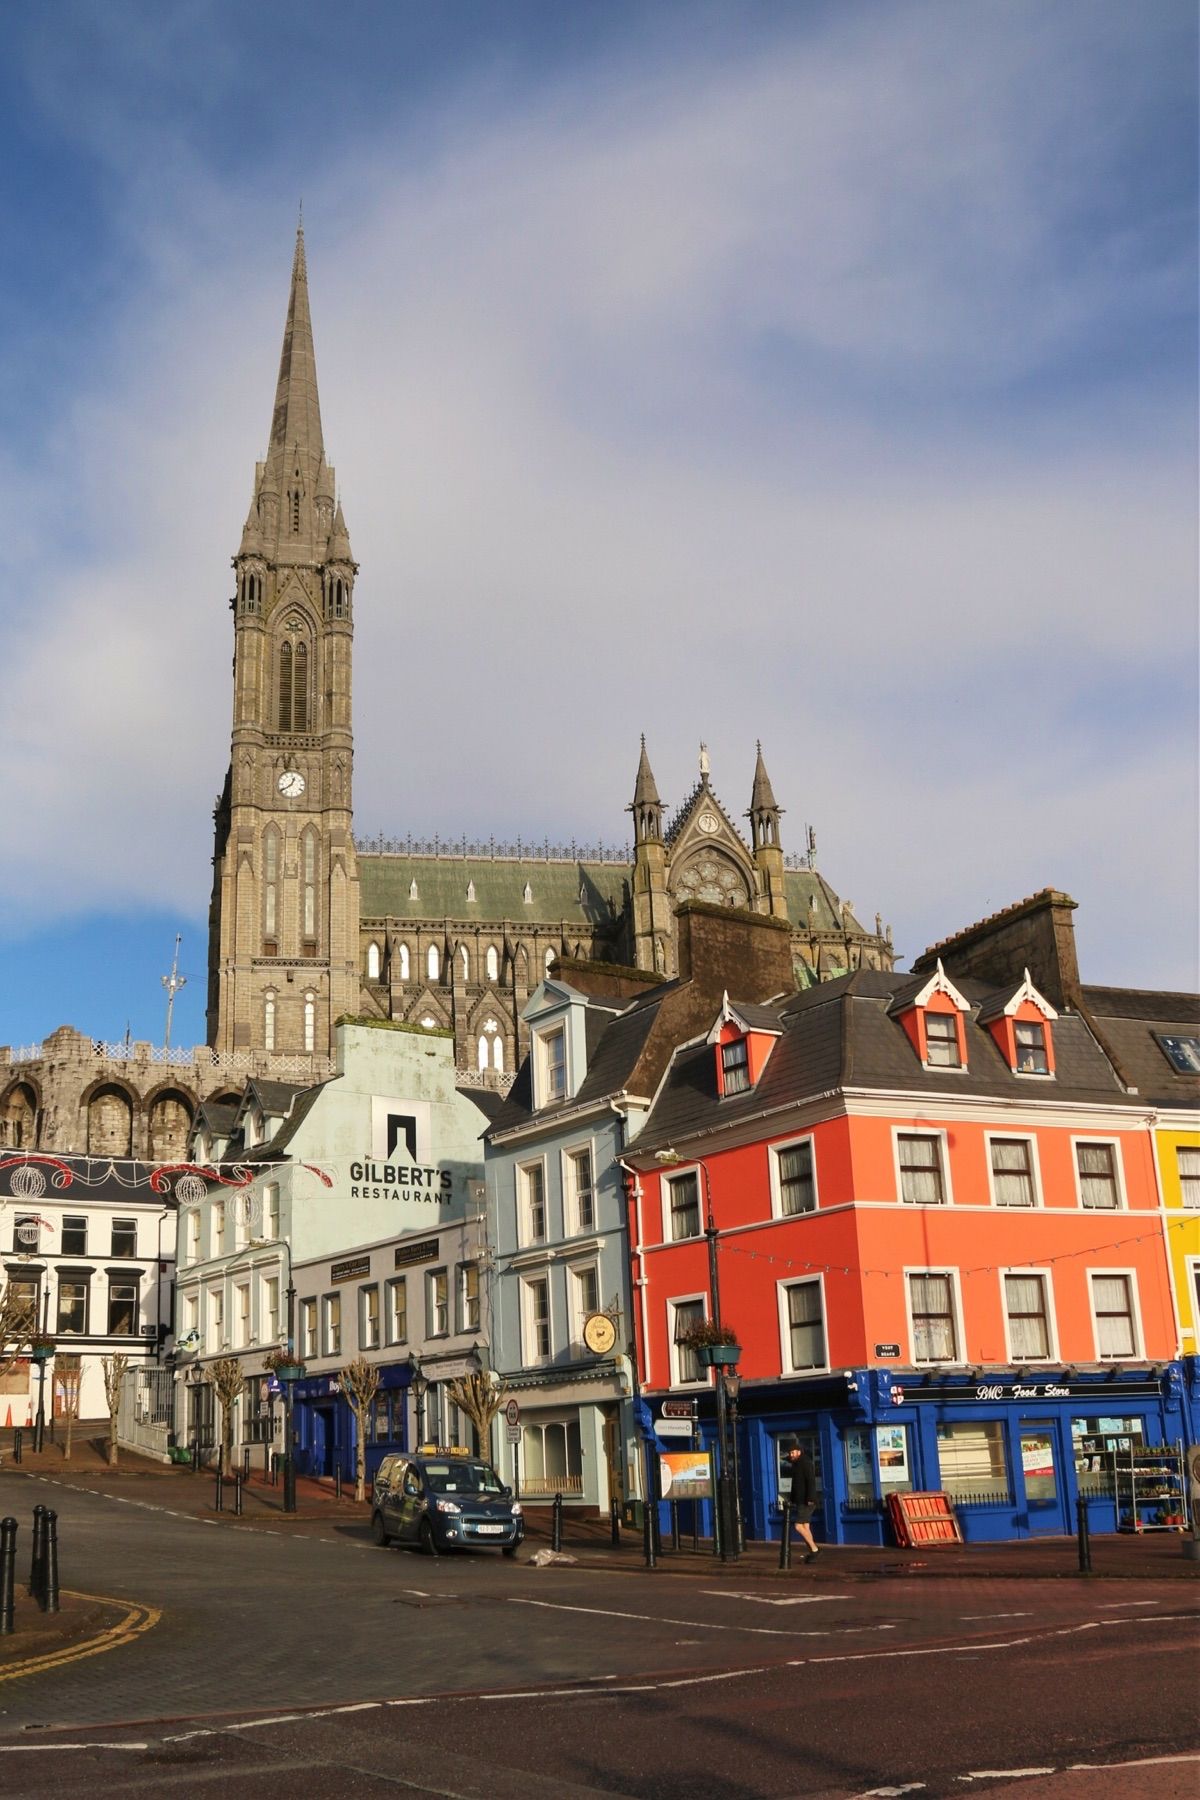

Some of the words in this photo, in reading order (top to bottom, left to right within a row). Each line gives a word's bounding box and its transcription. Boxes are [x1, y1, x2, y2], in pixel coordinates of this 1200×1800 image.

[350, 1162, 452, 1189] GILBERT'S
[351, 1186, 452, 1205] RESTAURANT
[976, 1385, 1003, 1400] BMC
[1012, 1385, 1037, 1399] Food
[1044, 1384, 1070, 1396] Store
